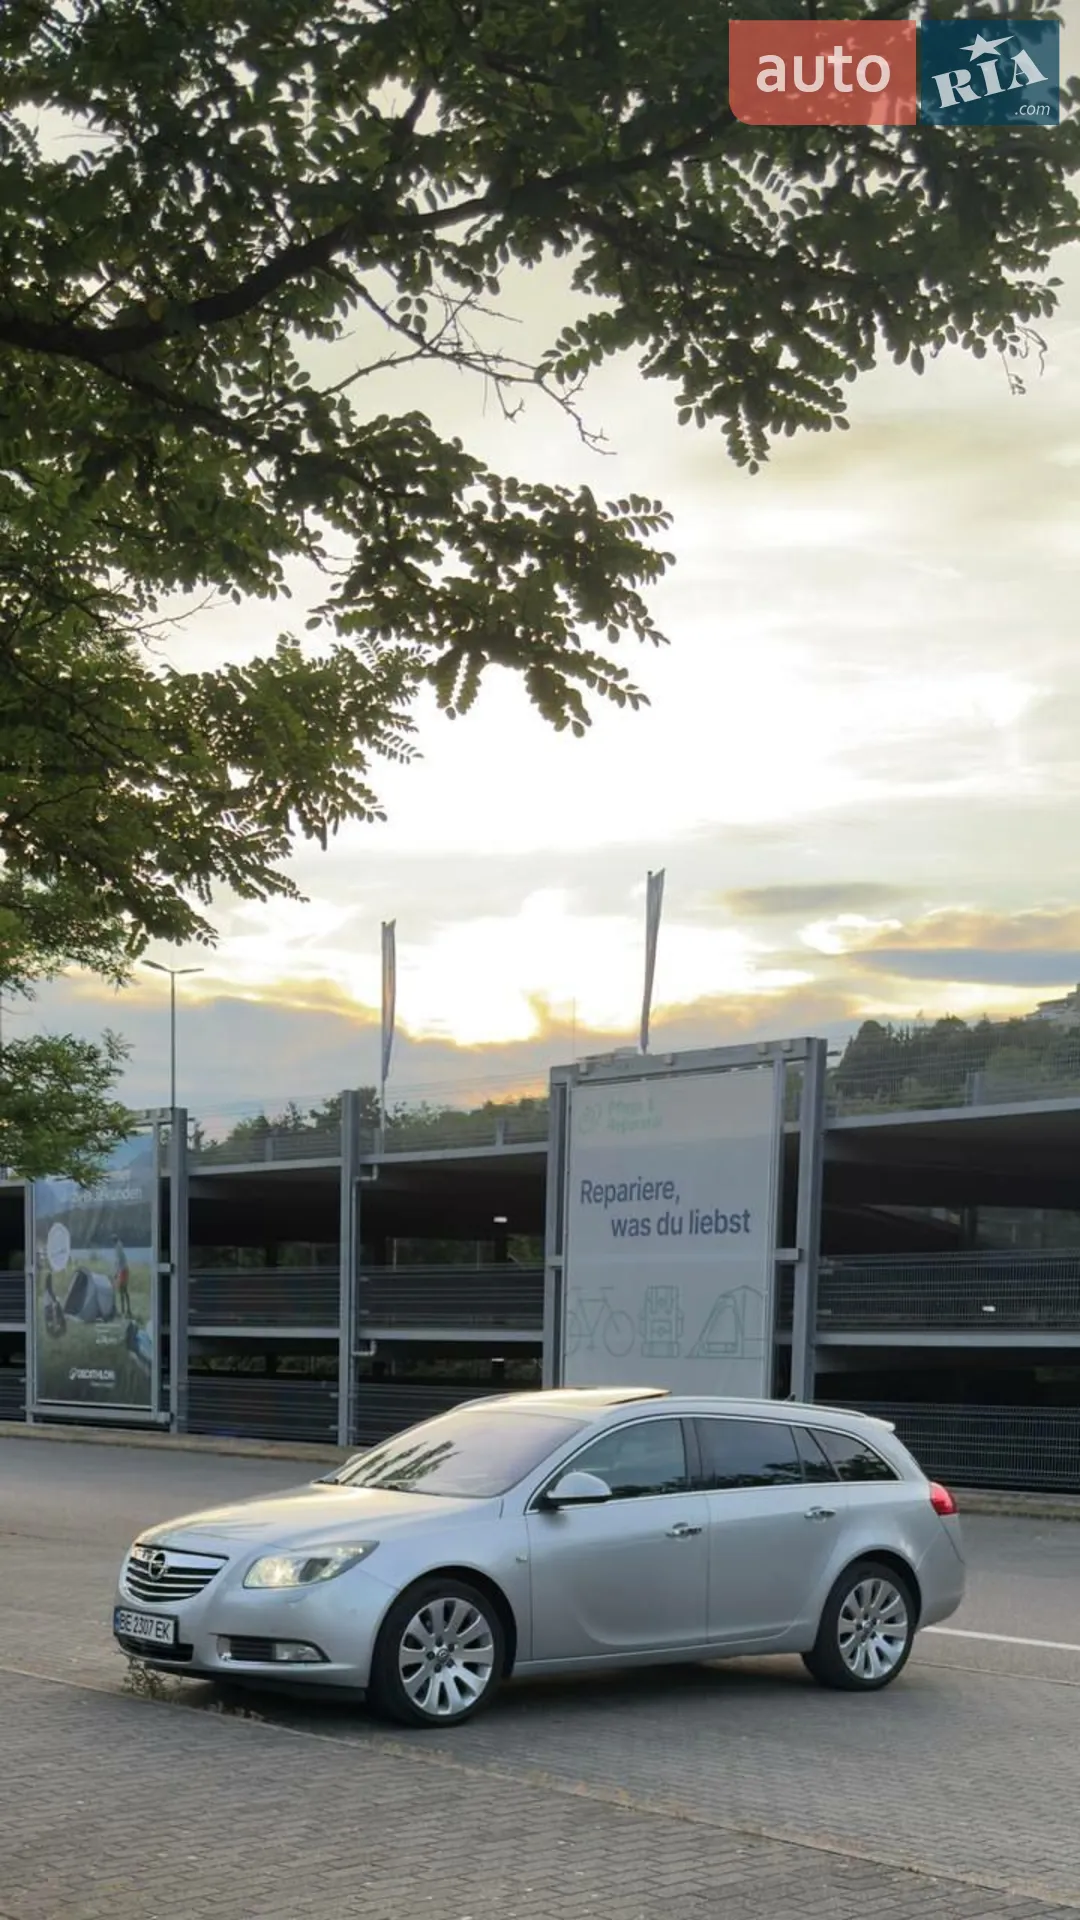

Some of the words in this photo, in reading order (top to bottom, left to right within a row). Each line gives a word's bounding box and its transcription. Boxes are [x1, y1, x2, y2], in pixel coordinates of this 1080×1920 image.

[580, 1176, 680, 1209] Repariere,
[611, 1216, 652, 1237] was
[656, 1211, 683, 1236] du
[688, 1208, 752, 1235] liebst
[120, 1612, 133, 1632] BE
[133, 1615, 155, 1637] 2307
[155, 1620, 171, 1640] EK
